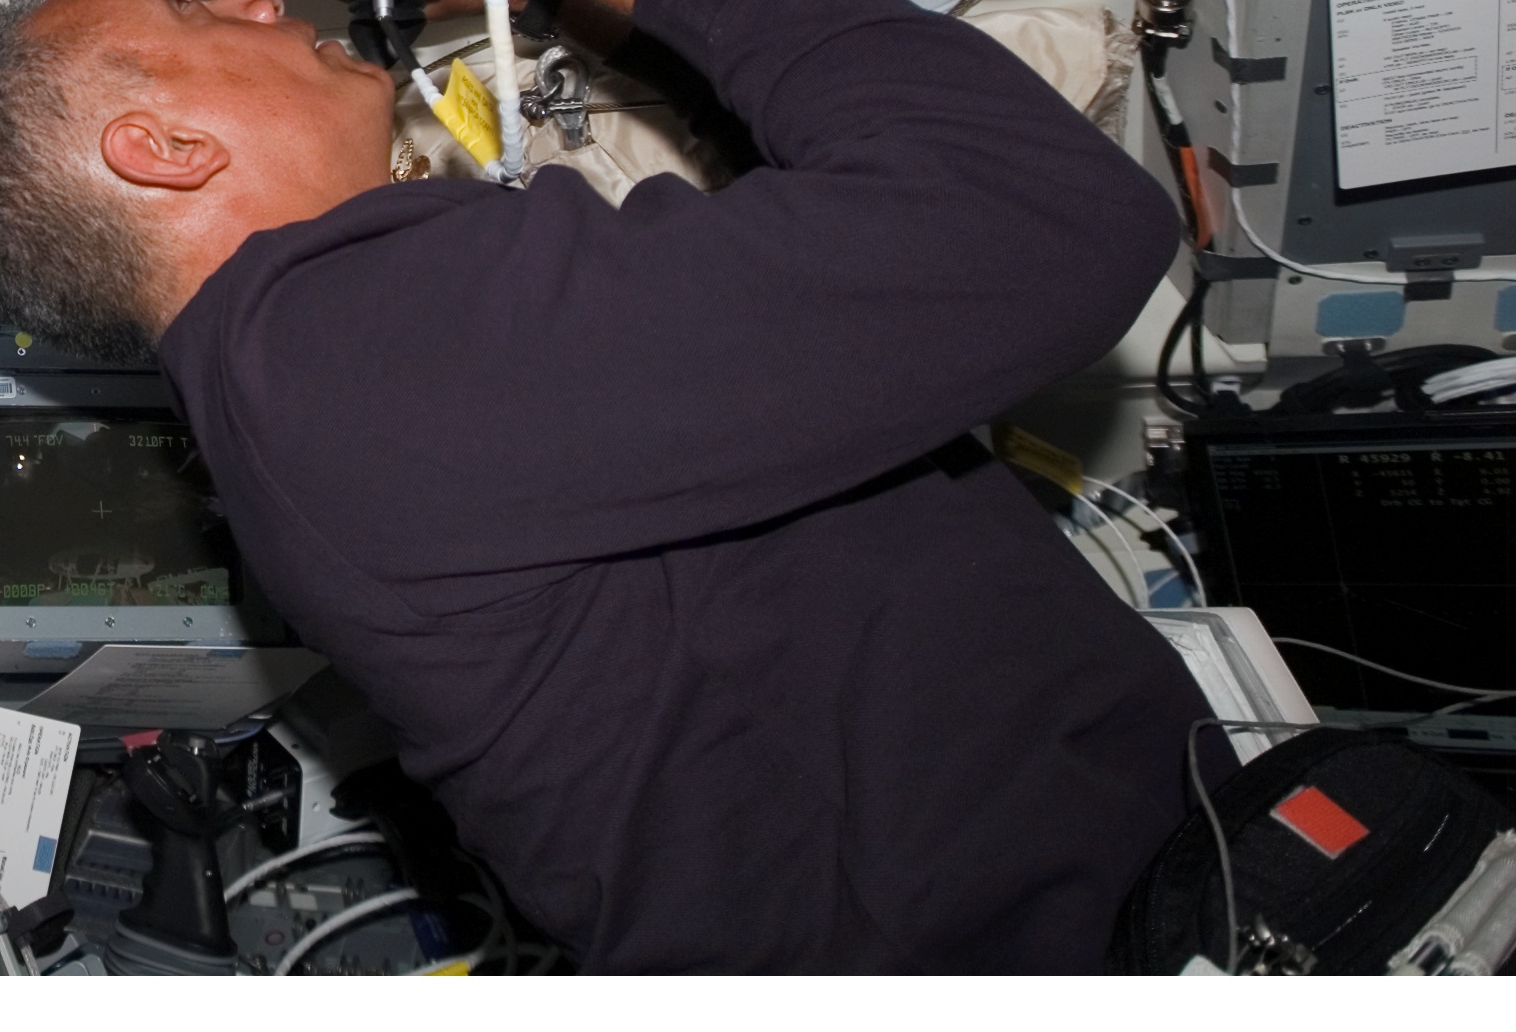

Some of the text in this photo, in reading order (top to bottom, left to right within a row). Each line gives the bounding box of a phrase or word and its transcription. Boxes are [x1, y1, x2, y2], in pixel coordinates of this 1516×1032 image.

[1340, 118, 1393, 131] DEACTIVATION
[1338, 451, 1505, 464] R 45929 -8.41
